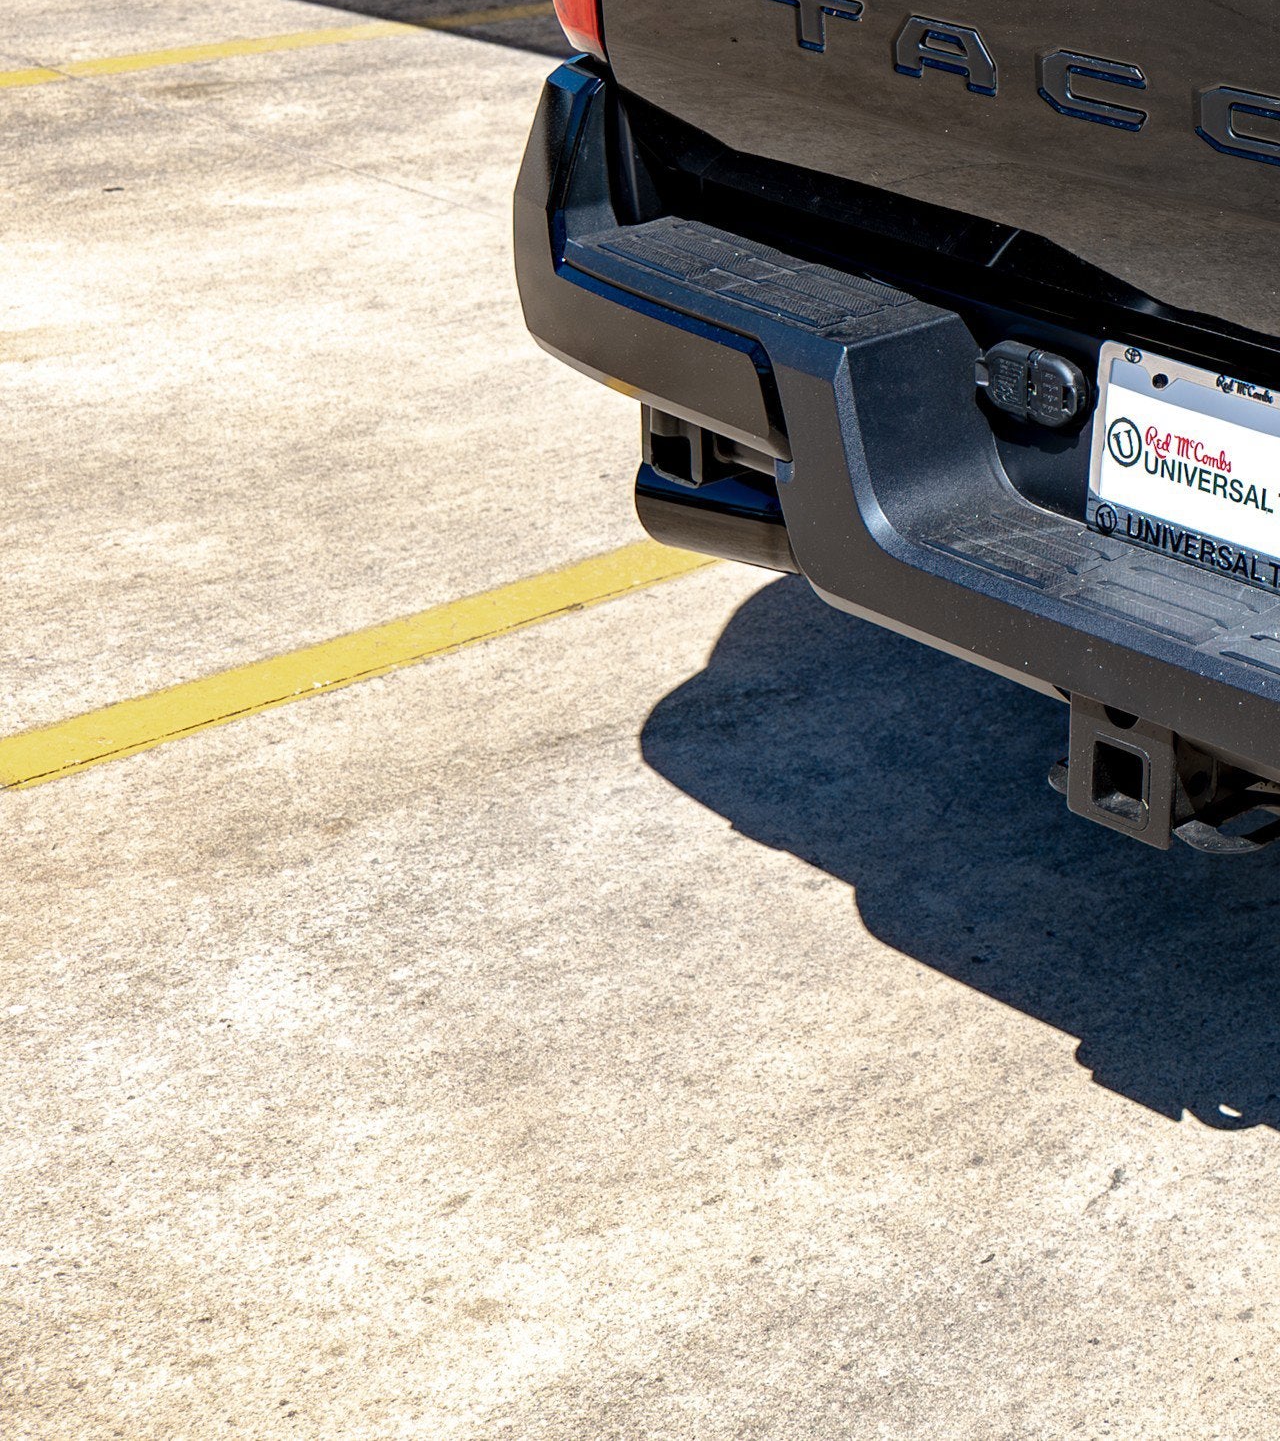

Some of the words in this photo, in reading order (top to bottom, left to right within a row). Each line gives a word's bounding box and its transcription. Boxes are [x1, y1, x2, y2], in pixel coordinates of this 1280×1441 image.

[1145, 426, 1171, 460] Red
[1175, 435, 1232, 473] McCombs
[1144, 451, 1274, 514] UNIVERSAL
[1126, 513, 1270, 582] UNIVERSAL
